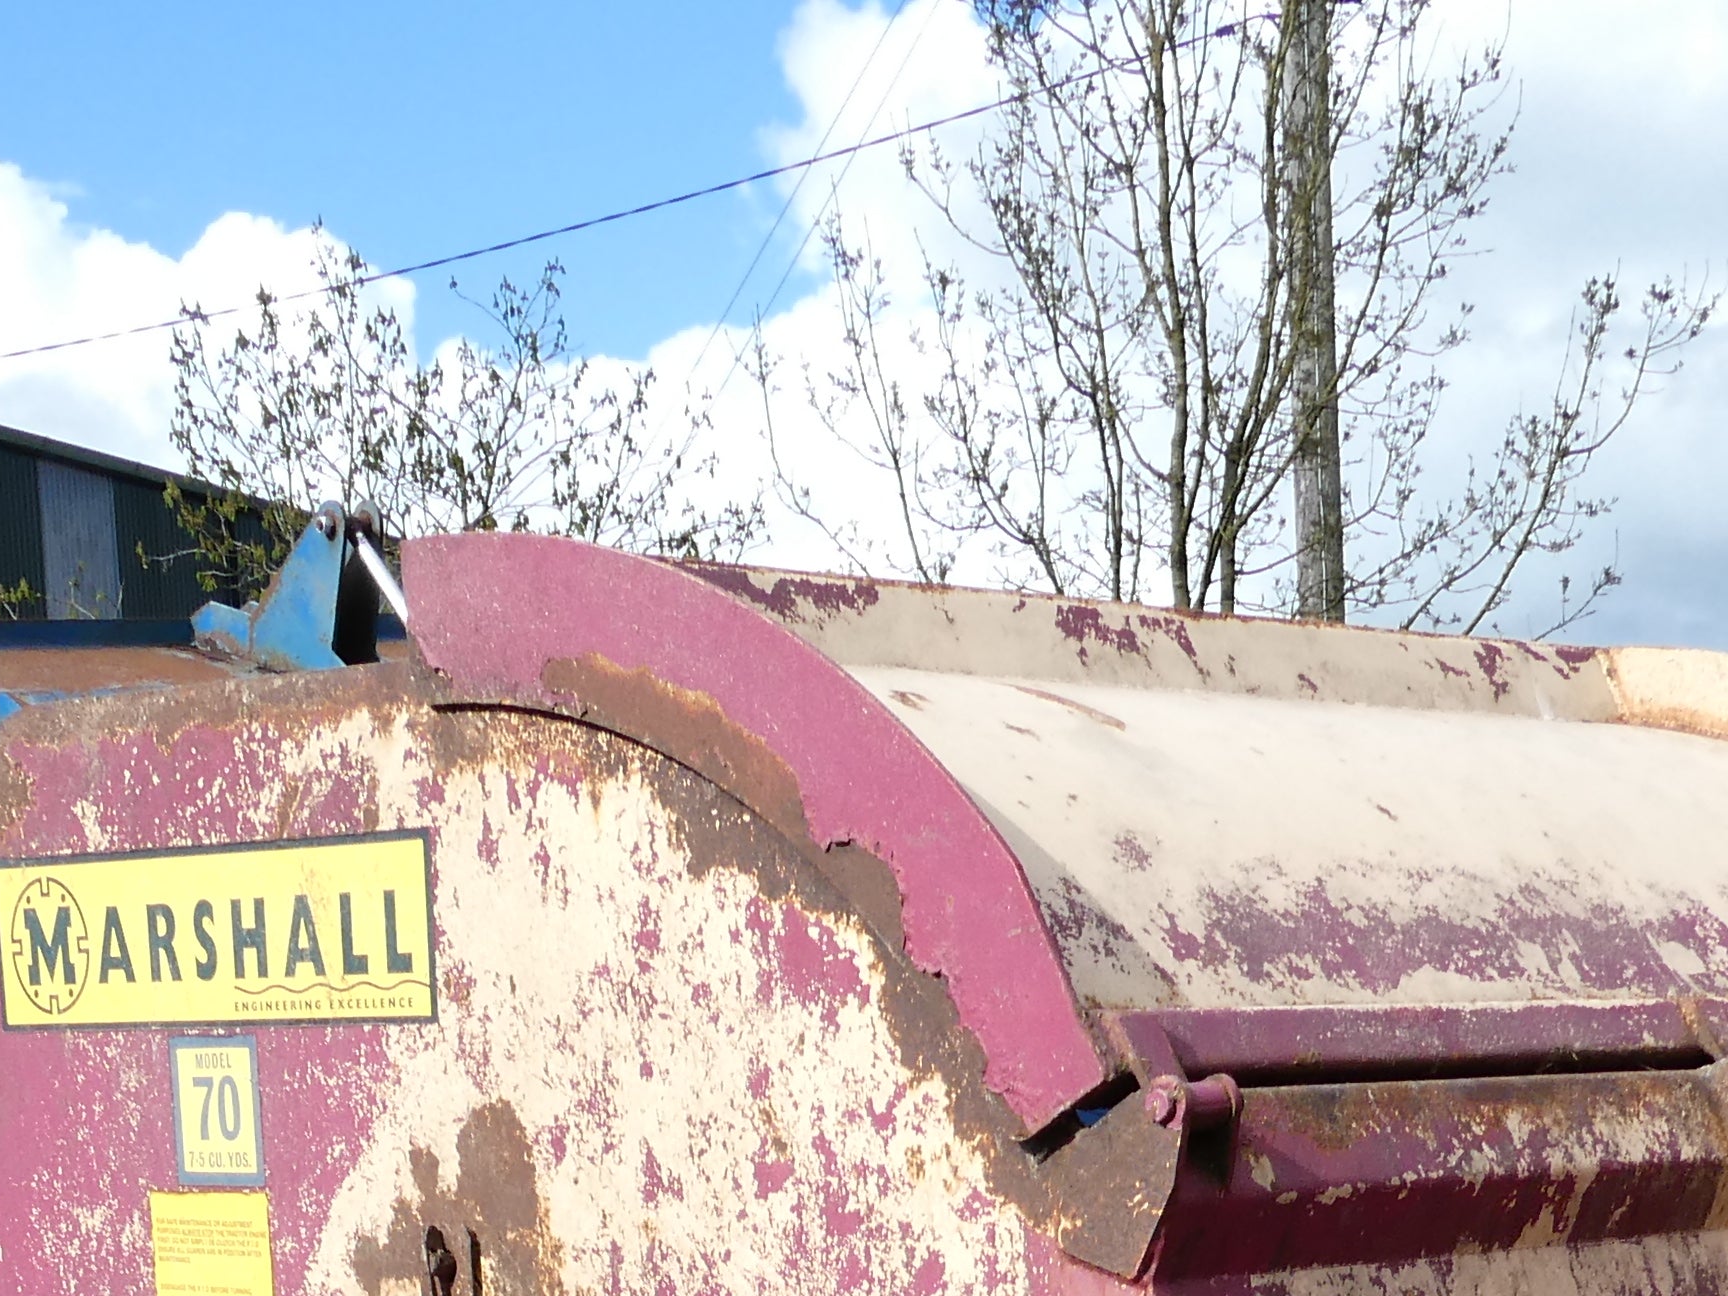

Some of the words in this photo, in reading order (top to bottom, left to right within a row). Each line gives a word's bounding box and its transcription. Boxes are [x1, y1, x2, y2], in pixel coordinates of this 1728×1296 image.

[23, 889, 414, 986] MARSHALL
[235, 1000, 321, 1012] ENGINEERING
[330, 998, 413, 1010] EXCELLENCE
[195, 1053, 231, 1068] MODEL
[192, 1075, 240, 1141] 70
